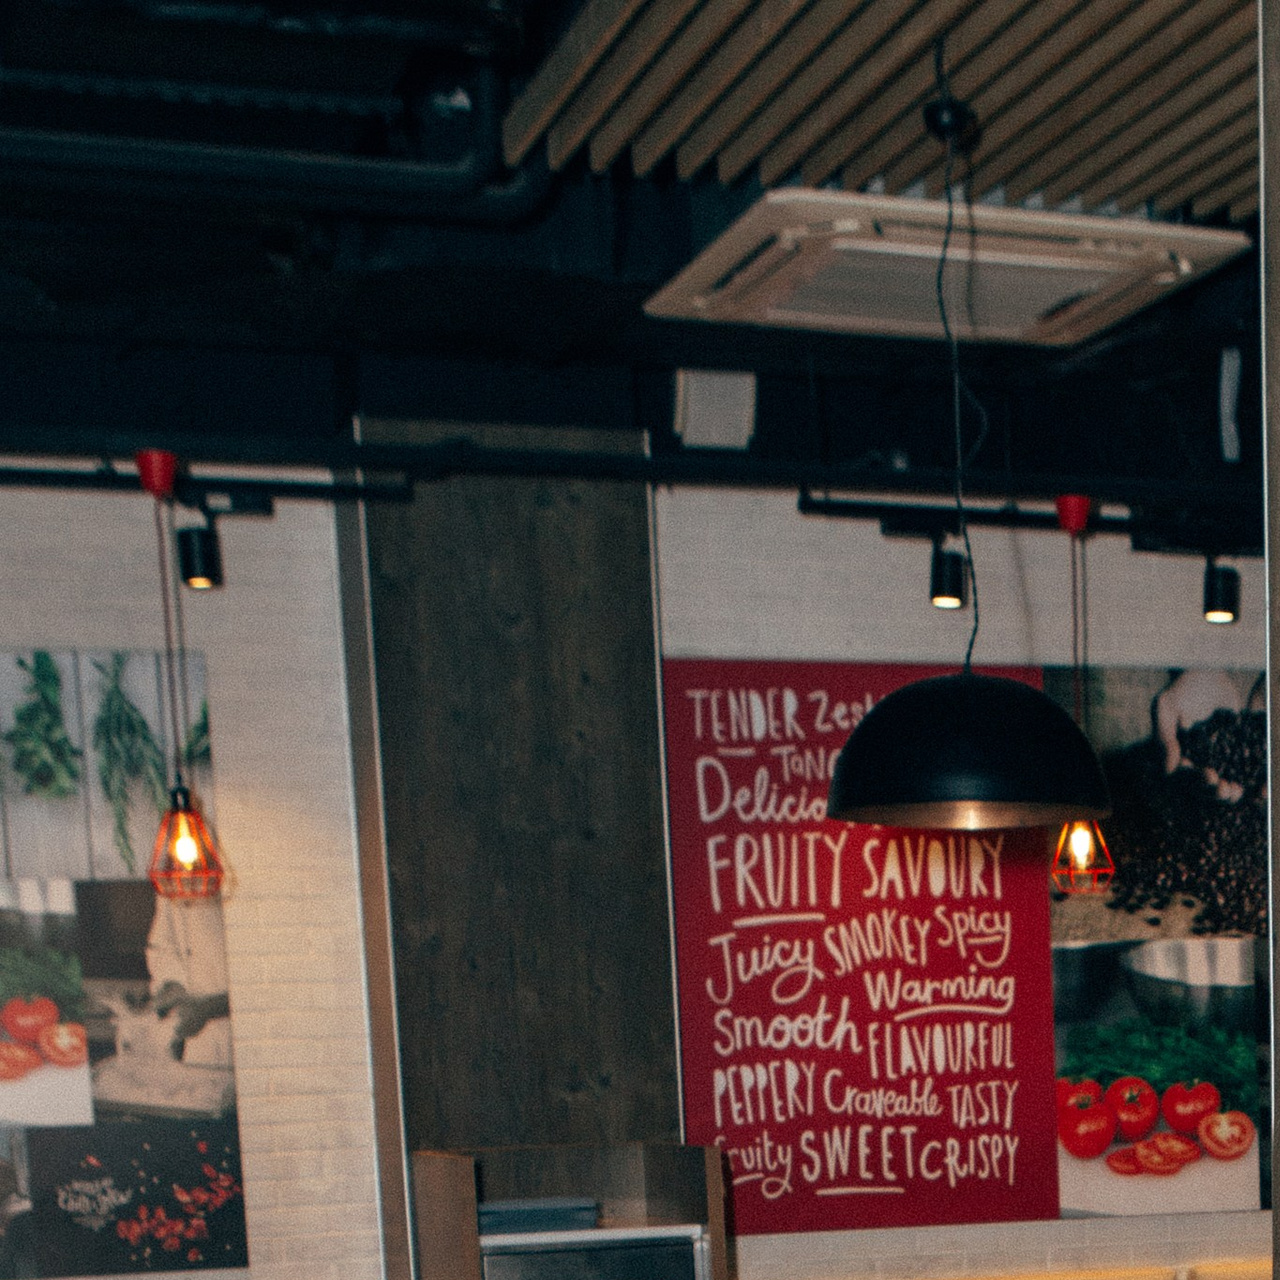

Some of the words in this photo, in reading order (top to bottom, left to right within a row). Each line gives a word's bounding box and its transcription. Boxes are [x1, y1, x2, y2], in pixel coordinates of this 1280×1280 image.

[684, 687, 806, 742] TENDER
[696, 755, 828, 823] Delicio
[706, 830, 848, 913] FRUITY
[862, 834, 1005, 900] SAVOURY
[705, 931, 825, 1004] Juicy
[823, 907, 931, 976] SMOKEY
[934, 904, 1012, 968] Spicy
[863, 964, 1016, 1021] Warming
[714, 995, 863, 1056] Smooth
[868, 1020, 1015, 1080] FLAVOURFUL
[713, 1060, 815, 1128] PEPPERY
[824, 1068, 943, 1119] Craveable
[947, 1080, 1019, 1130] TASTY
[801, 1124, 918, 1183] SWEET
[919, 1133, 1020, 1188] CRISPY
